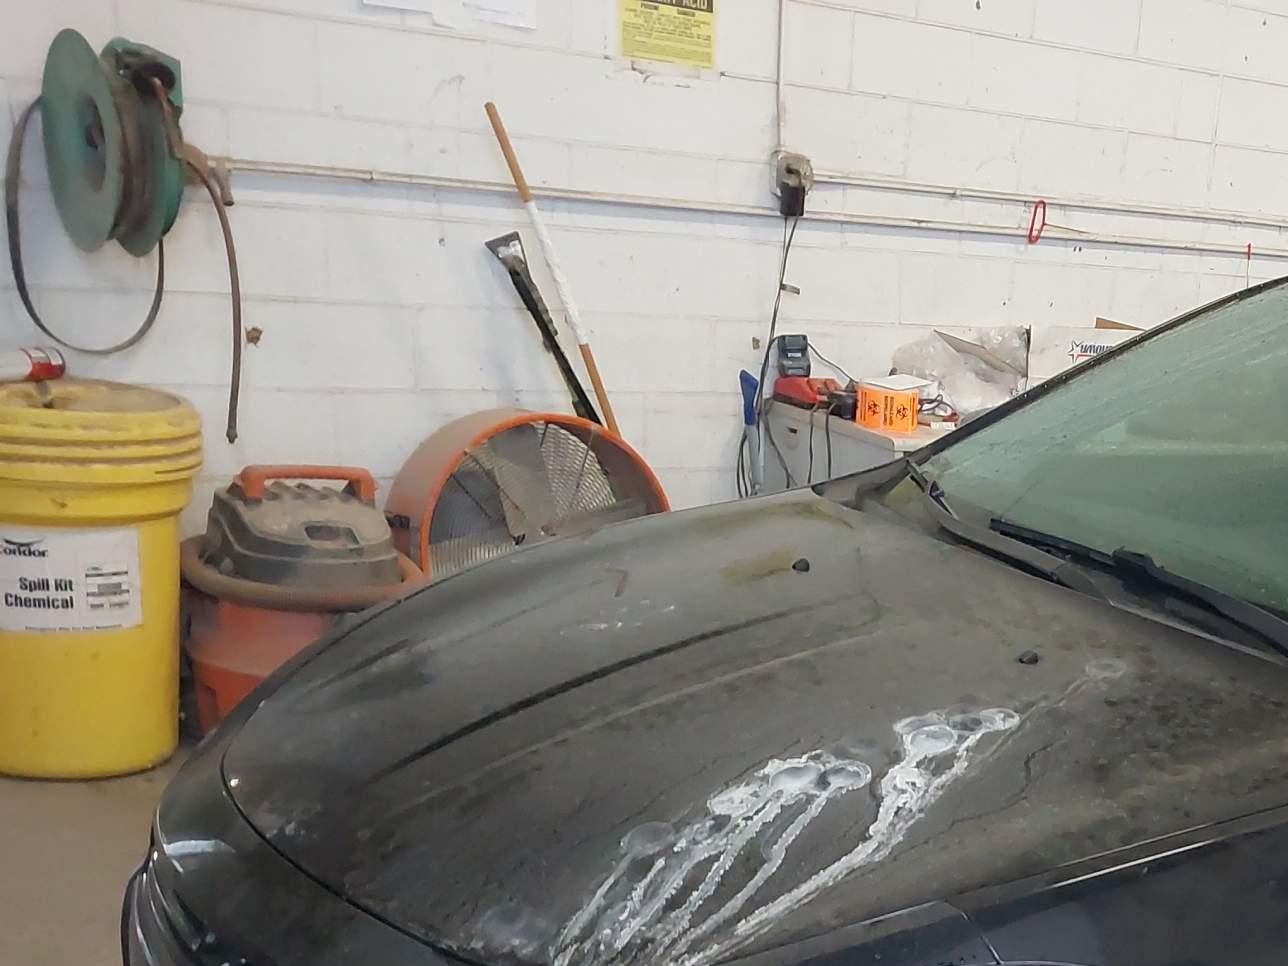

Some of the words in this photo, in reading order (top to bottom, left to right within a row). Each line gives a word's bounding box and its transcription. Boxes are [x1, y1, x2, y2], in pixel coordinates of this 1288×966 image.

[0, 545, 49, 558] ondor
[19, 576, 50, 593] Spill
[54, 578, 74, 592] Kit
[4, 592, 74, 609] Chemical
